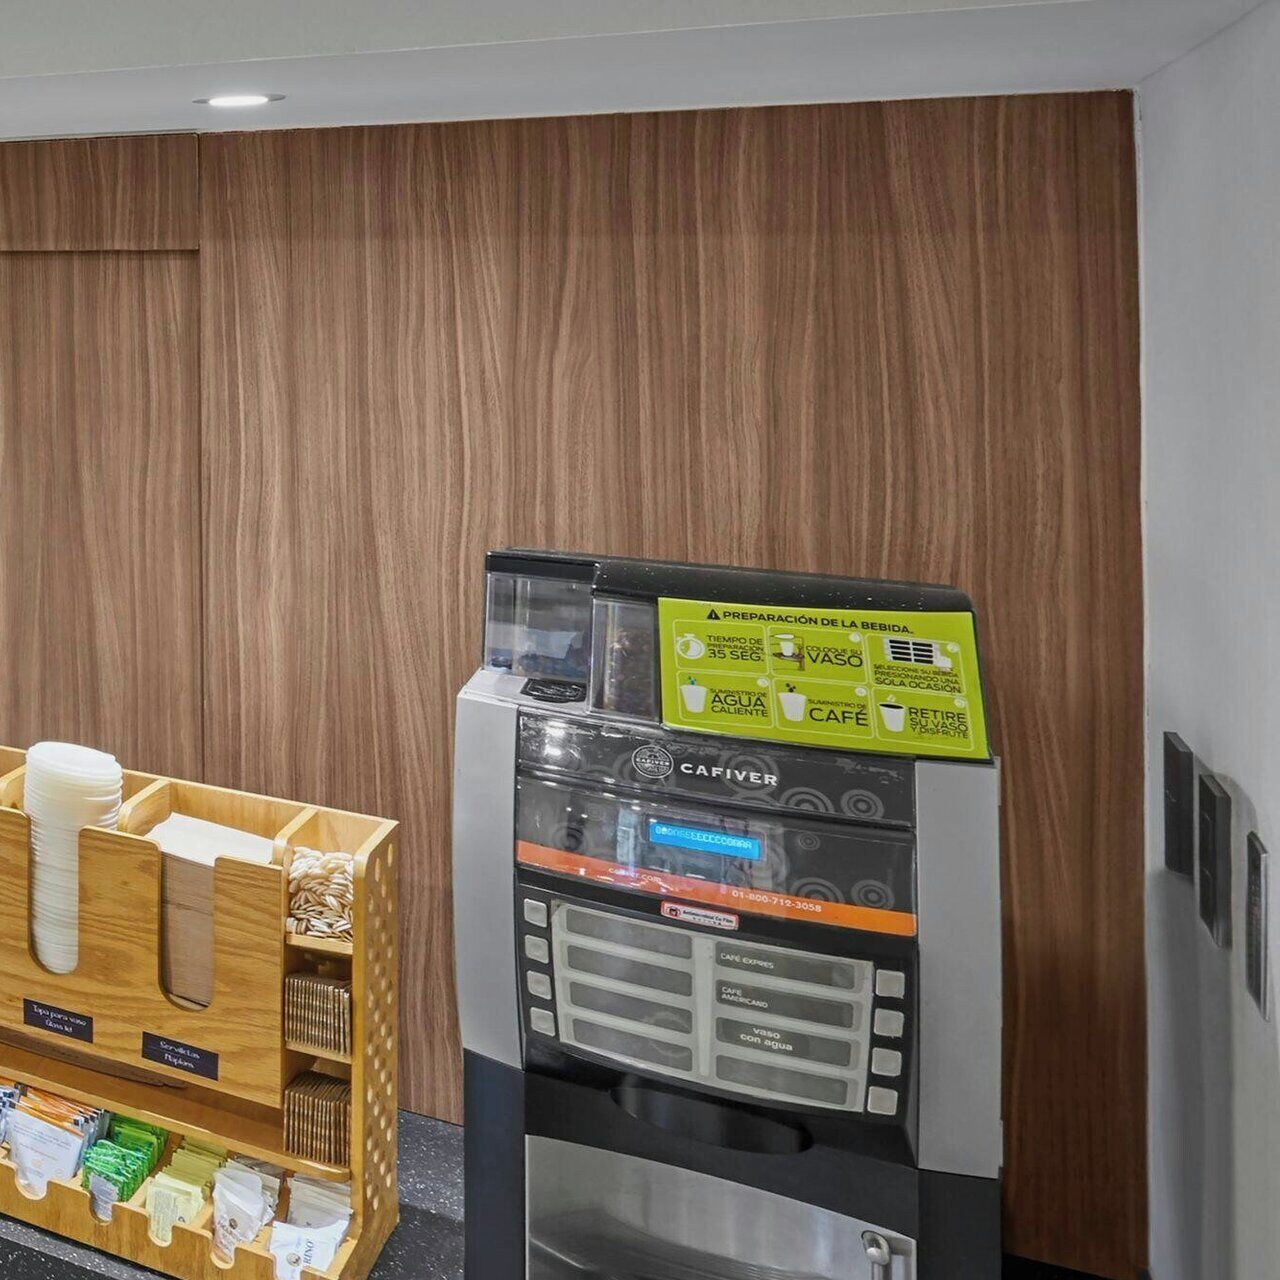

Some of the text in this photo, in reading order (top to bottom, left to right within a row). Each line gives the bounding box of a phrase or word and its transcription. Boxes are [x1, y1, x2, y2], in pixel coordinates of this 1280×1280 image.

[723, 611, 818, 626] PREPARACIÓN
[821, 617, 838, 627] DE
[842, 619, 858, 629] LA
[708, 634, 763, 646] TIEMPO DE
[708, 648, 764, 662] 35 SEG.
[806, 645, 848, 654] COLOQUE
[807, 652, 863, 667] VASO
[875, 670, 939, 683] PRESIONANDO
[710, 687, 756, 697] SUMINISTRO
[875, 677, 961, 694] SOLA OCASIÓN
[711, 694, 766, 708] AGUA
[808, 698, 855, 708] SUMINISTRO
[711, 706, 768, 718] CALIENTE
[809, 708, 868, 727] CAFÉ
[909, 707, 966, 723] RETIRE
[910, 717, 968, 732] SU VASO
[920, 726, 968, 739] DISFRUTE
[636, 757, 670, 766] CAFIVER
[680, 763, 778, 786] CAFIVER
[731, 889, 822, 913] 01-800-712-3058
[742, 957, 774, 969] EXPRES
[721, 994, 768, 1008] AMERICANO
[752, 1028, 780, 1039] vaso
[740, 1034, 793, 1051] con agua
